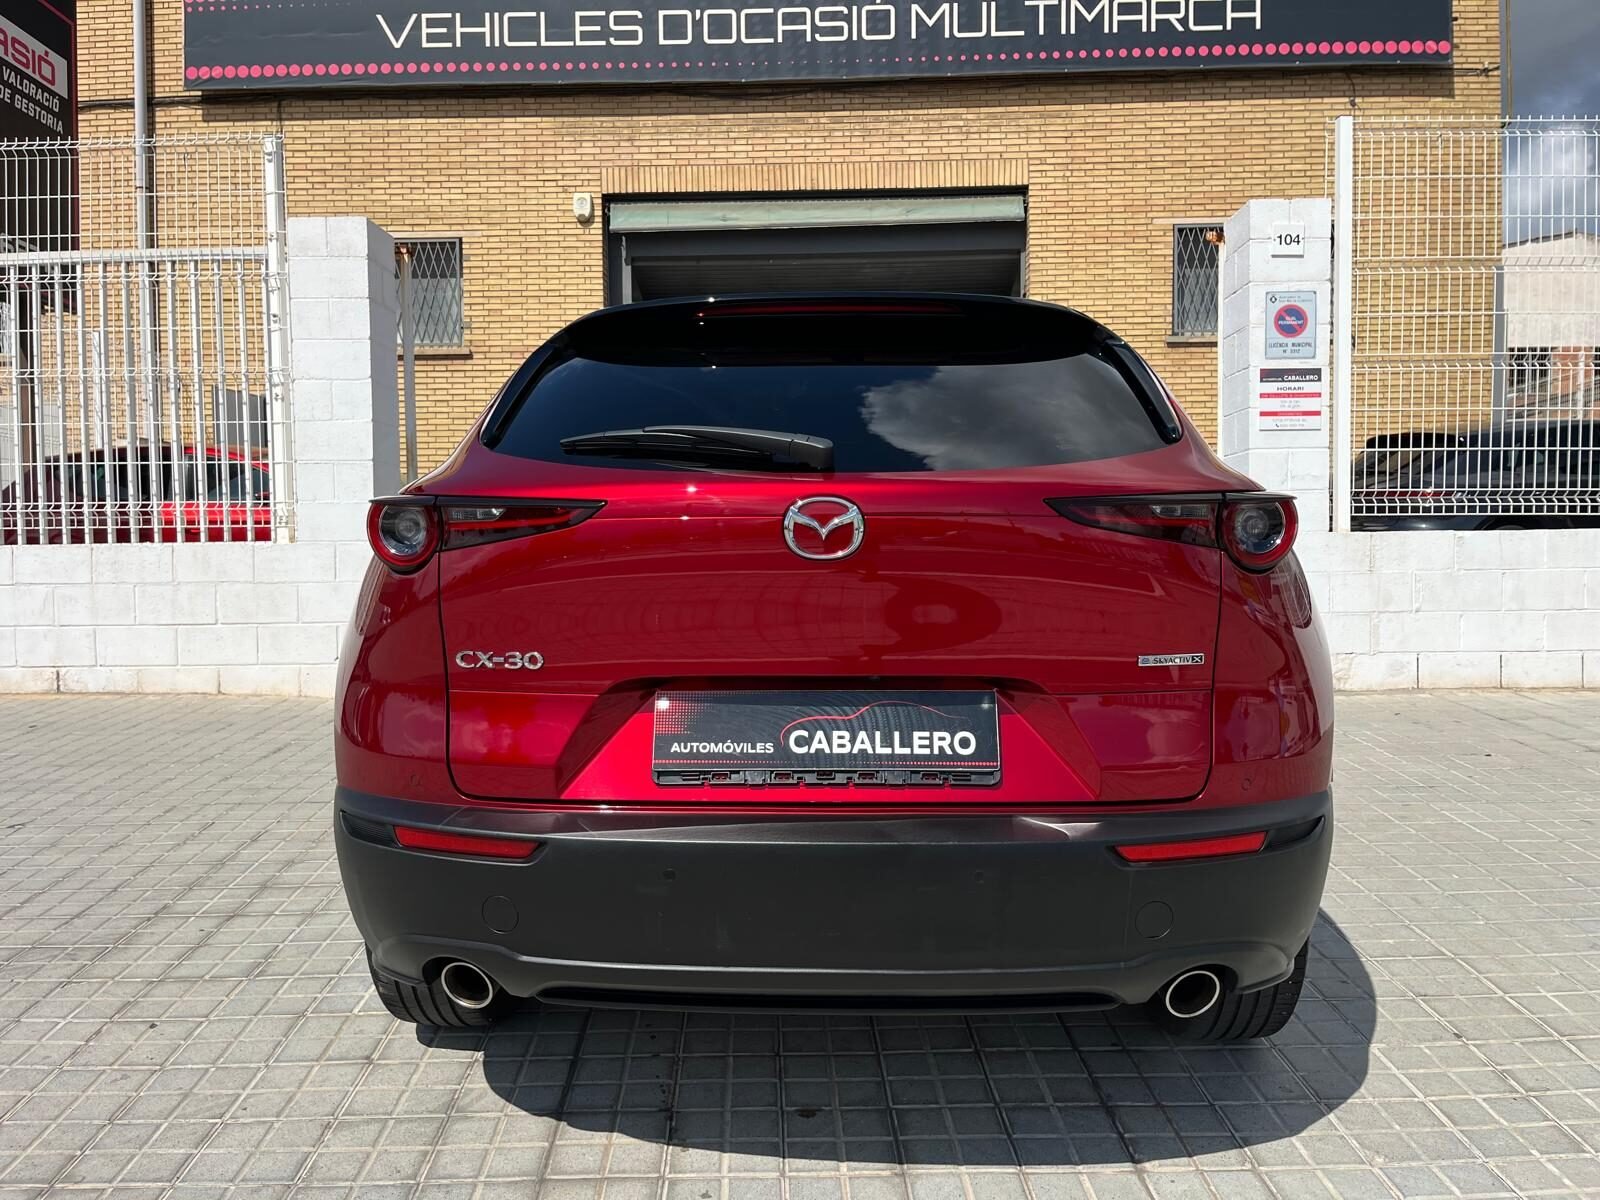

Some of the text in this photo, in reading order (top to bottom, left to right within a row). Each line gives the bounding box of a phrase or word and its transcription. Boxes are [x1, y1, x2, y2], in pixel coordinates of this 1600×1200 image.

[376, 0, 1261, 49] VEHICLES D'OCASIÓ MULTIMARCA
[2, 65, 60, 113] VALORACIÓ
[14, 93, 63, 135] GESTORIA
[1276, 233, 1301, 246] 104
[455, 650, 544, 670] CX-30
[670, 729, 977, 756] AUTOMÓVILES CABALLERO
